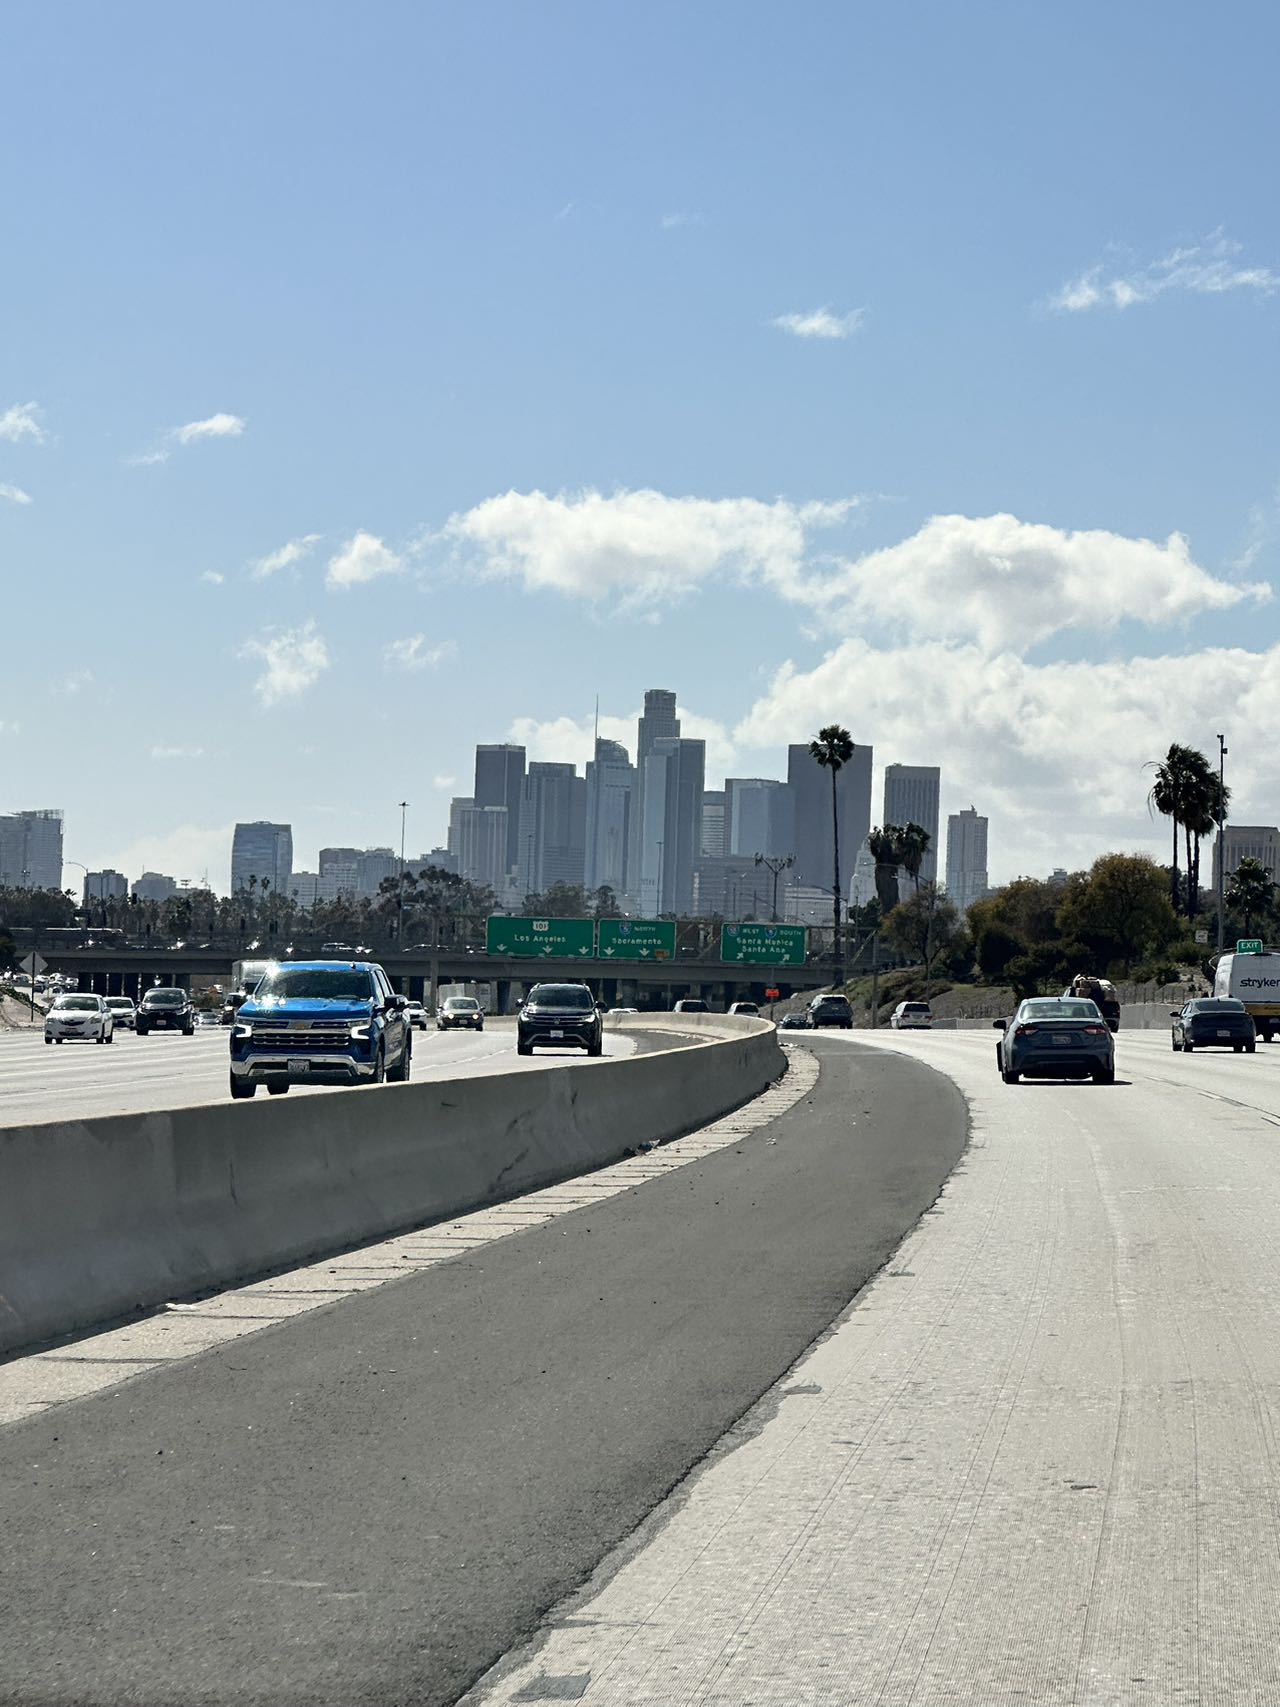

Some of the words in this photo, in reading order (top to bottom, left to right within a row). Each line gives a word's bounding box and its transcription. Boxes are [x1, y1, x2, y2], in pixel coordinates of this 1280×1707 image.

[514, 934, 530, 942] Los
[533, 935, 566, 943] Angeles
[612, 937, 662, 945] Sacramento
[765, 938, 794, 946] Monica
[742, 945, 766, 953] Santa
[1240, 978, 1280, 988] stryker
